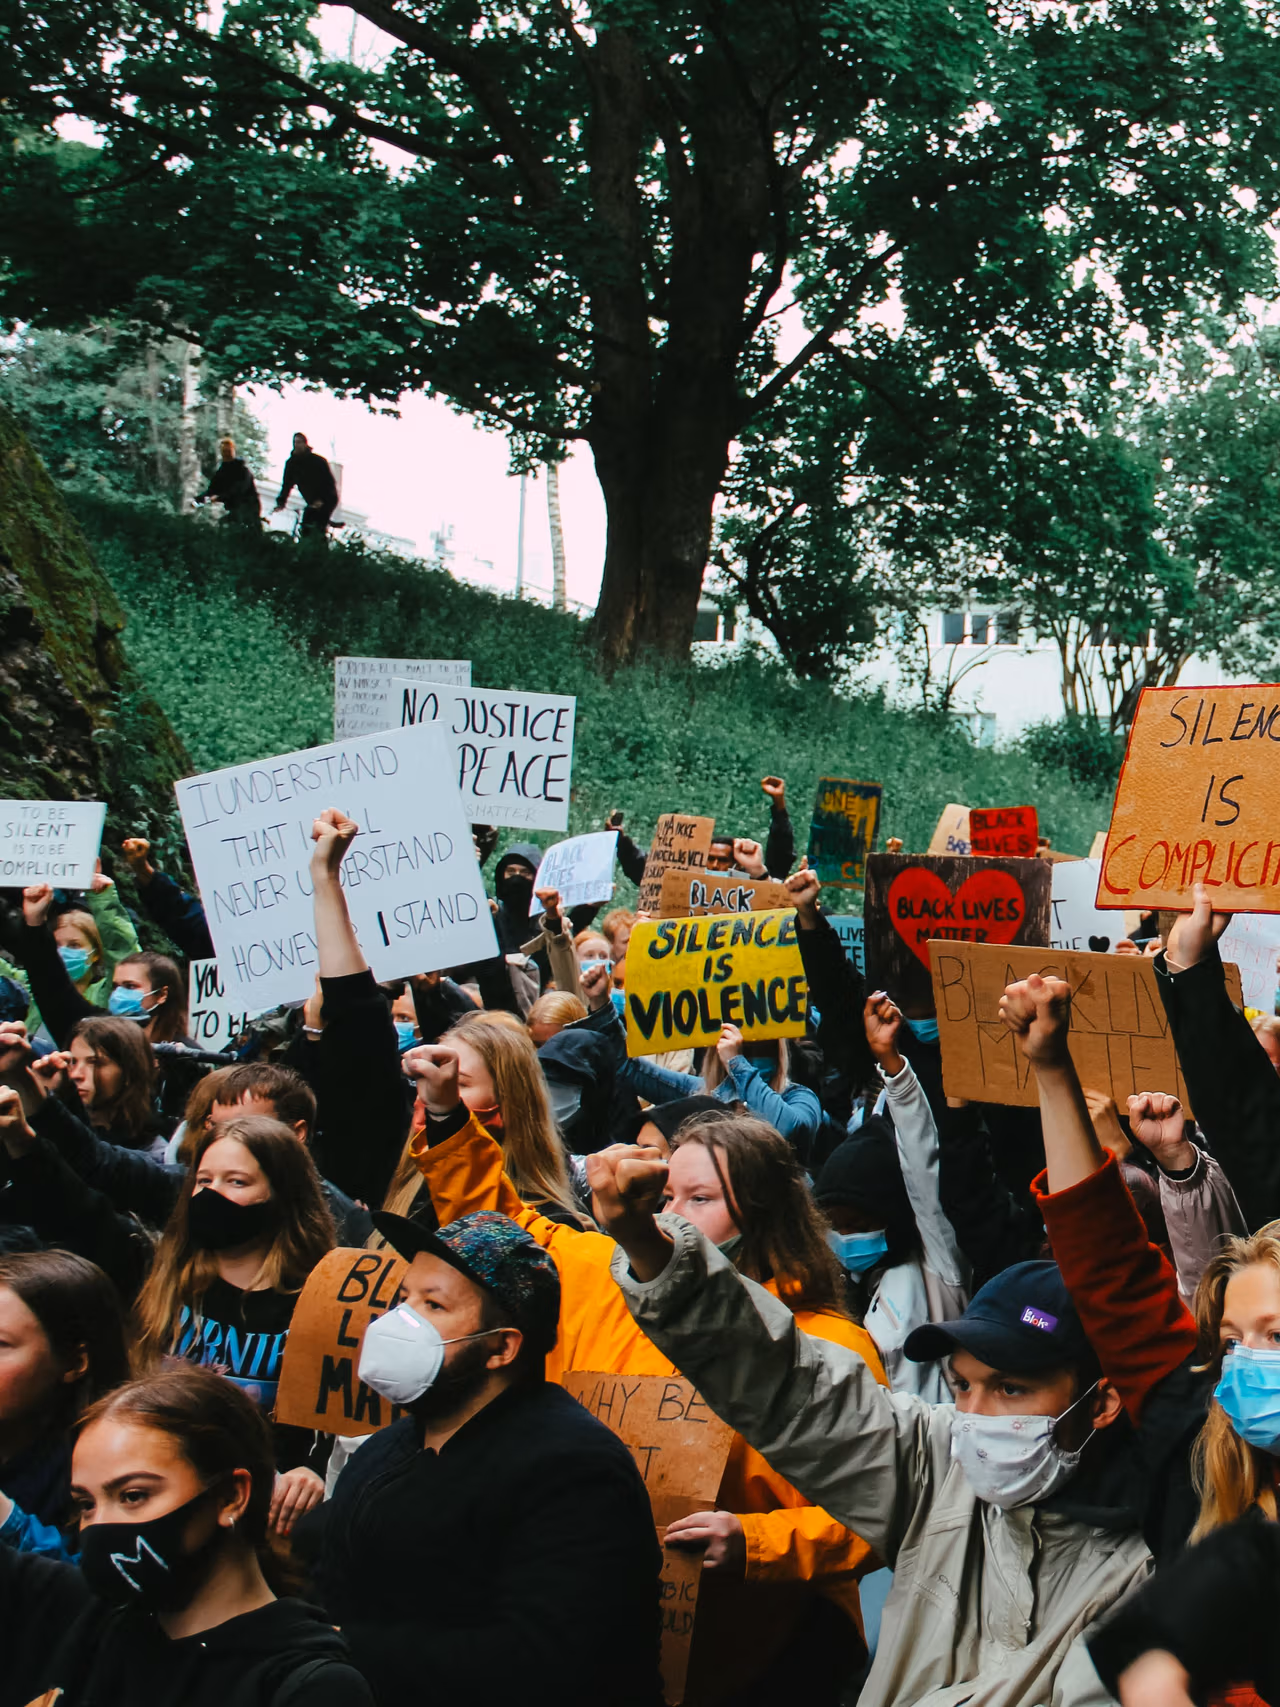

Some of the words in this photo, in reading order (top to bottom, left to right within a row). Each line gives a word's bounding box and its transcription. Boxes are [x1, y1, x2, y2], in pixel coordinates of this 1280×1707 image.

[401, 687, 440, 728] NO
[452, 697, 571, 743] JUSTICE
[187, 781, 220, 829] I
[215, 745, 399, 816] UNDERSTAND
[456, 742, 569, 803] PEACE
[20, 806, 40, 820] TO
[48, 807, 68, 820] BE
[1201, 774, 1244, 826] IS
[4, 821, 76, 839] SILENT
[972, 811, 1025, 832] BLACK
[13, 843, 25, 855] IS
[31, 844, 45, 855] TO
[49, 843, 66, 855] BE
[221, 822, 288, 868] THAT
[298, 820, 309, 851] I
[972, 834, 1033, 854] LIVES
[0, 860, 80, 876] OMPLICIT
[213, 873, 289, 924] NEVER
[295, 831, 453, 897] UERSTAND
[690, 879, 756, 913] BLACK
[896, 896, 956, 921] BLACK
[962, 898, 1021, 922] LIVES
[377, 910, 390, 947] I
[393, 892, 479, 939] STAND
[648, 915, 799, 960] SILENCE
[916, 926, 989, 944] MATTER
[703, 953, 734, 983] IS
[192, 1010, 219, 1041] TO
[628, 975, 808, 1041] VIOLENCE
[657, 1383, 709, 1424] BE
[110, 1535, 169, 1592] M
